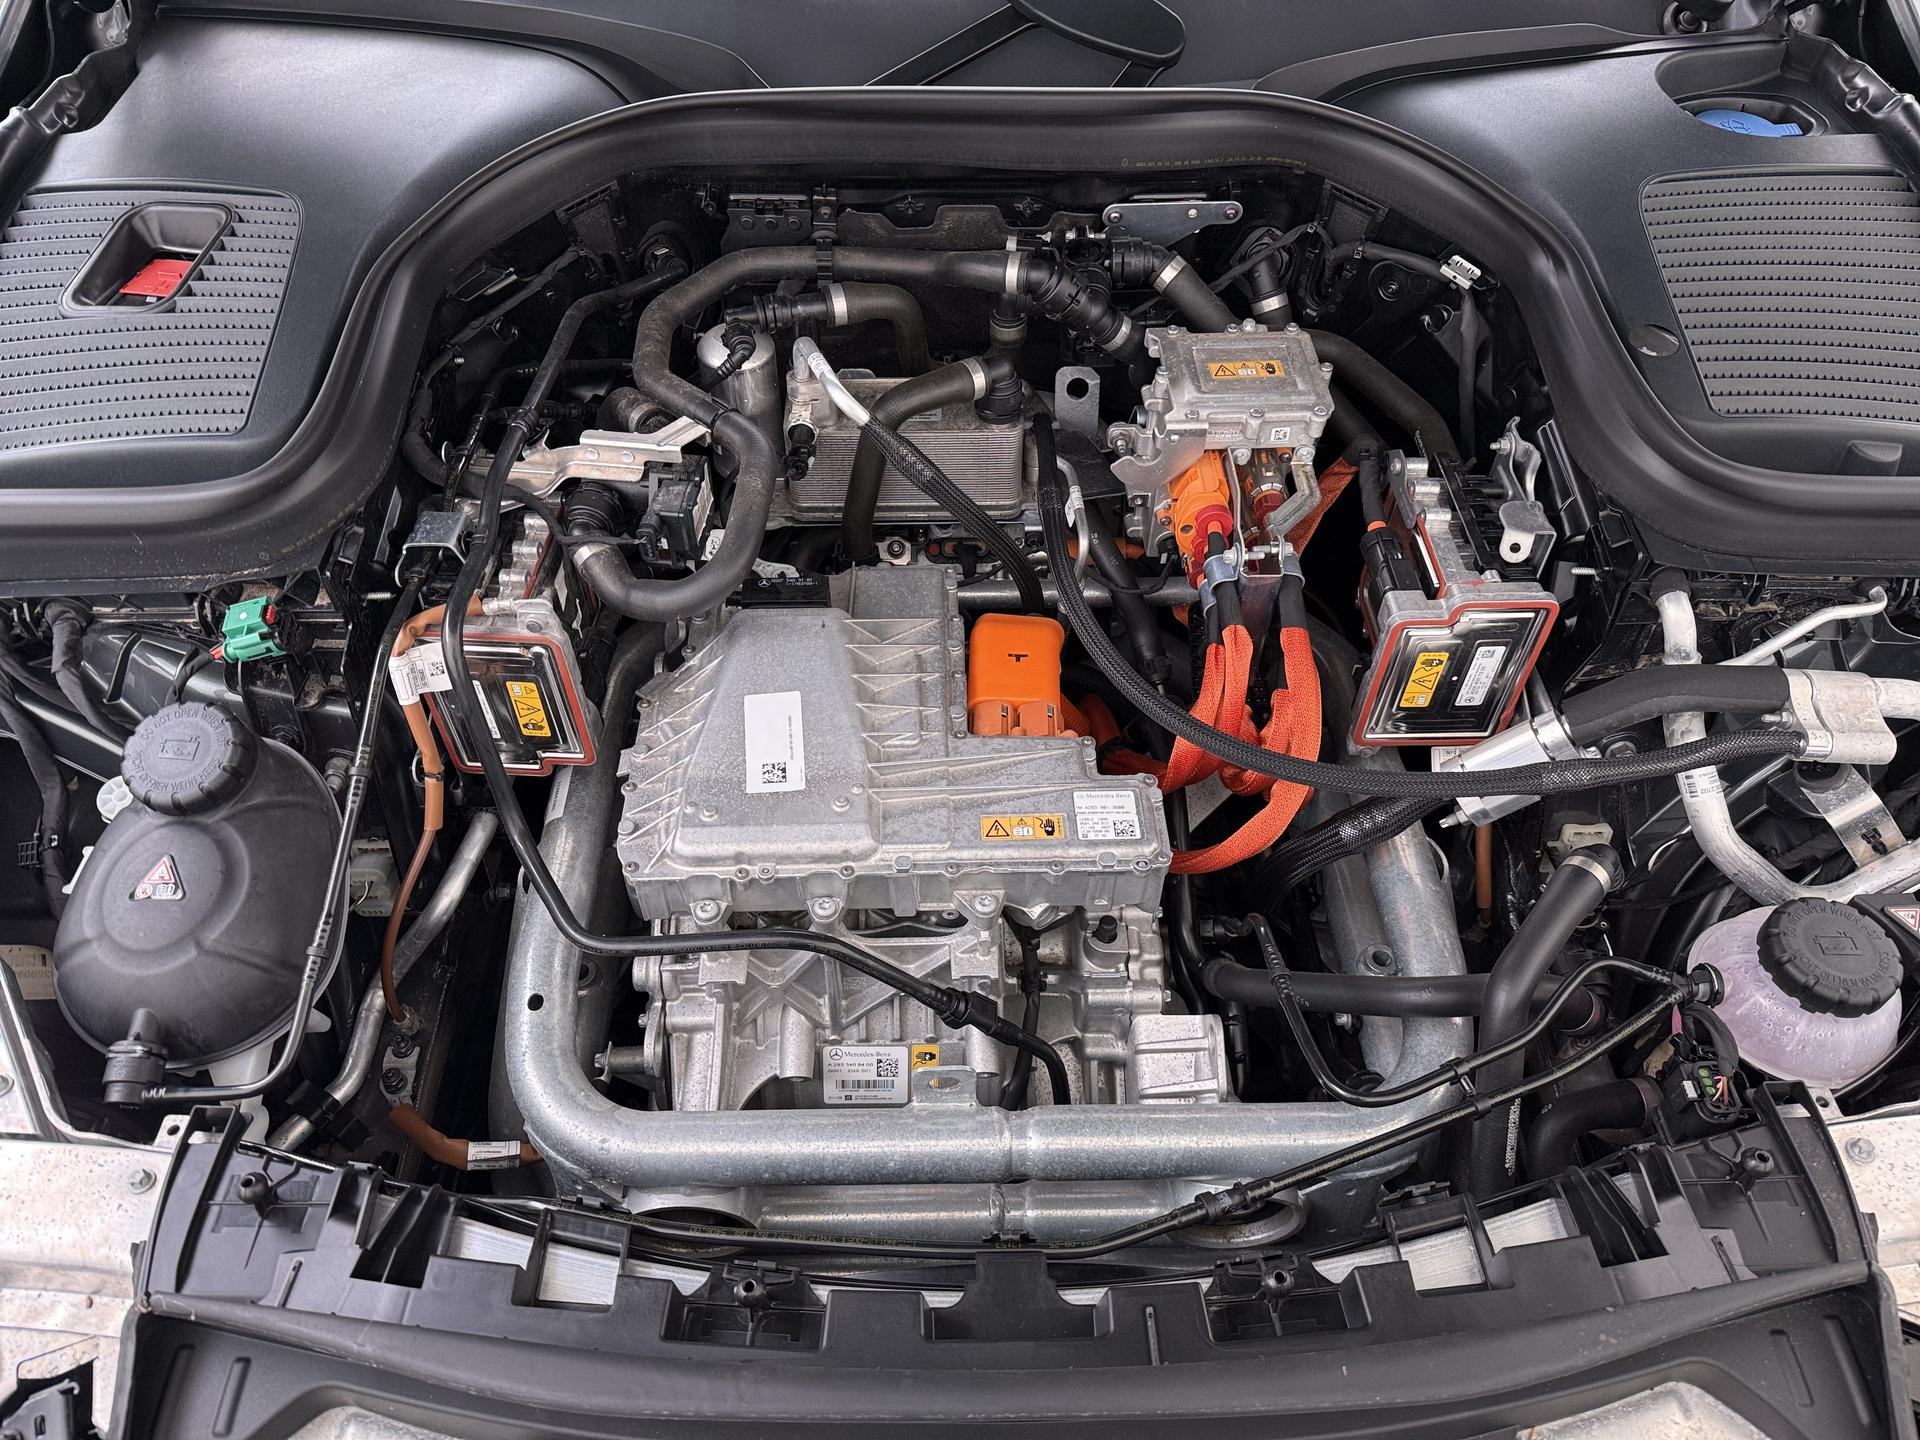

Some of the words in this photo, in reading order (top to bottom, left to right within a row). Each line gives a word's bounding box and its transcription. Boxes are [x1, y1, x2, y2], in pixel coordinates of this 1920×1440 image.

[154, 713, 172, 729] NOT
[174, 709, 199, 719] OPEN
[170, 776, 198, 791] WENN
[1700, 786, 1716, 795] 2702
[1801, 905, 1828, 916] OPEN
[1830, 906, 1860, 925] WHEN
